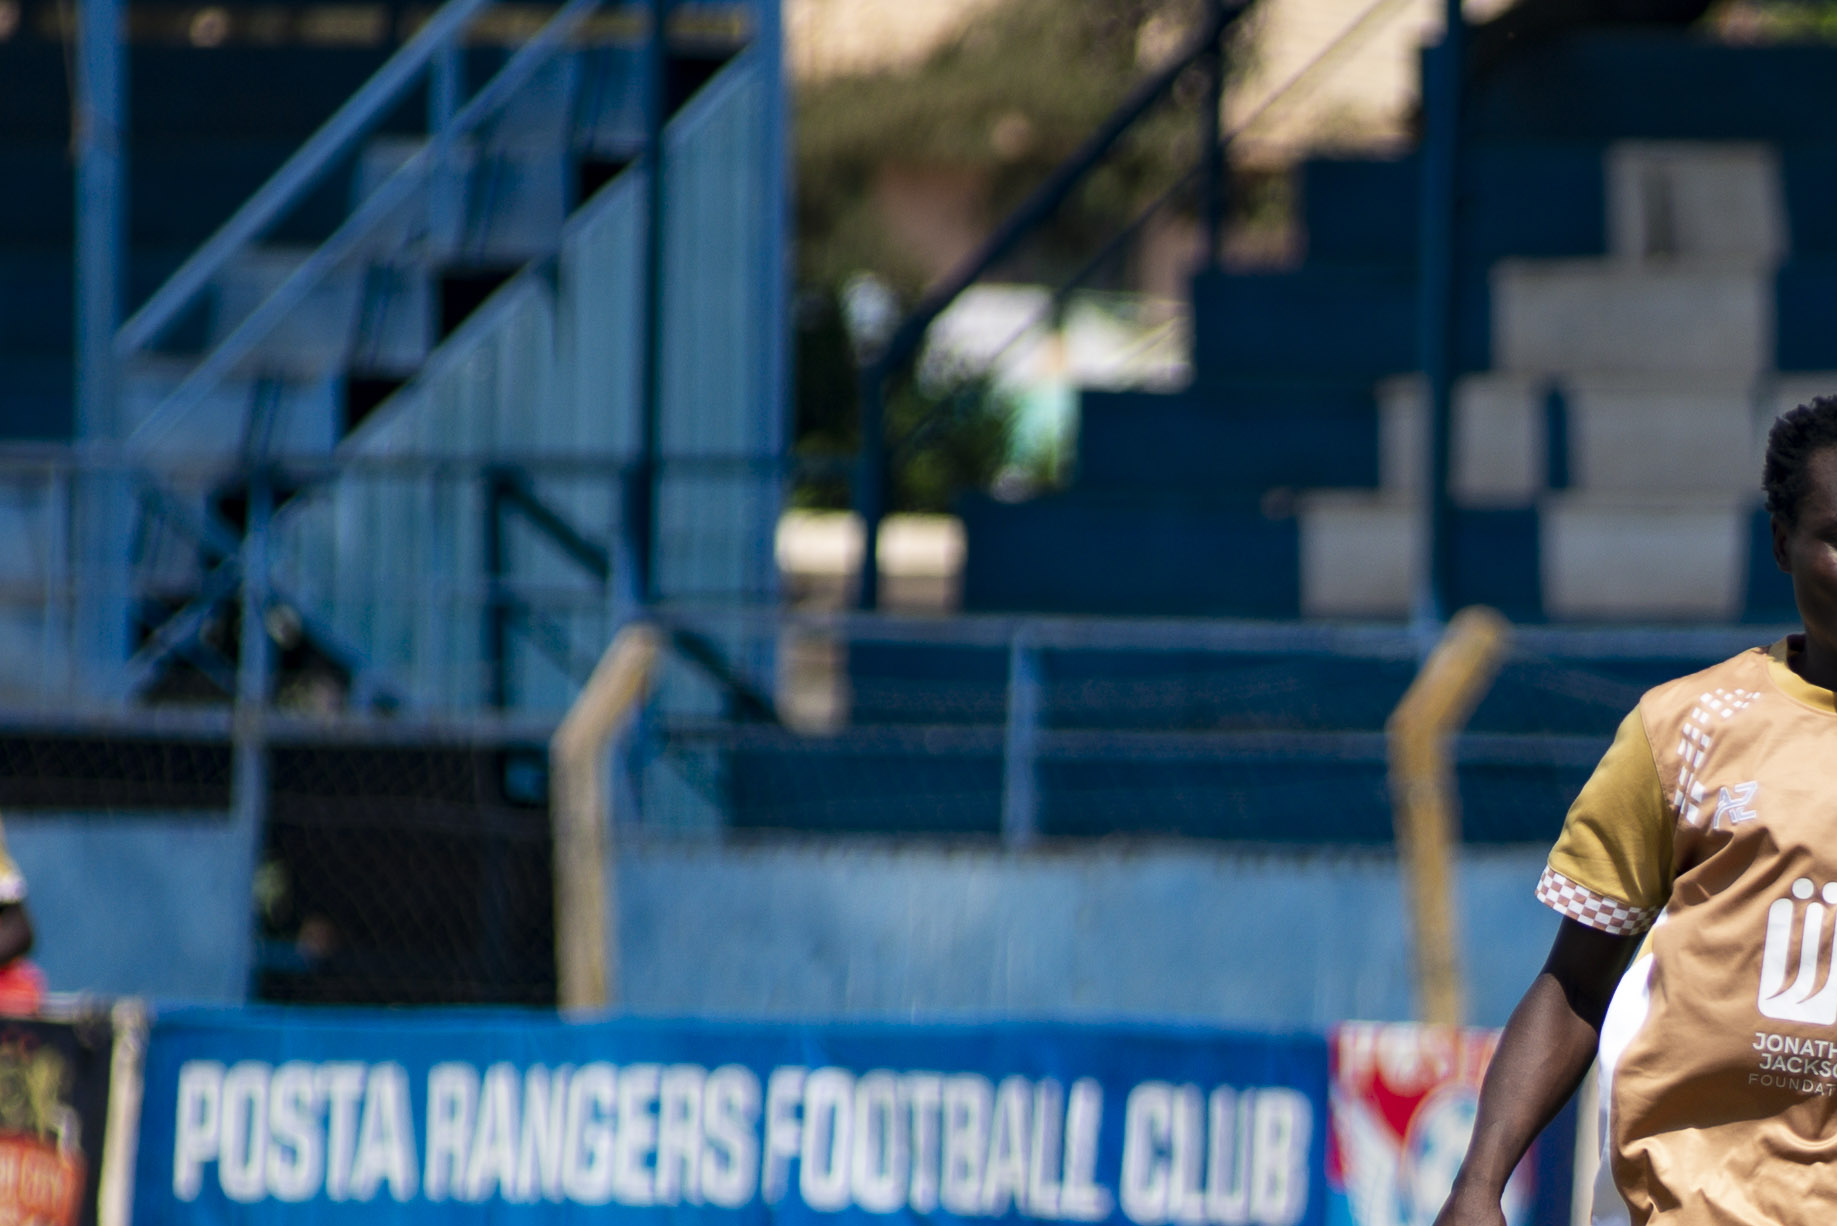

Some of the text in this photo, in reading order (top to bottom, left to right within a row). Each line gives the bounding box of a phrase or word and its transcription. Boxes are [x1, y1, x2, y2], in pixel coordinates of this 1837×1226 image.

[172, 1059, 418, 1203] POSTA
[423, 1060, 762, 1207] RANGERS
[762, 1062, 1113, 1222] FOOTBALL
